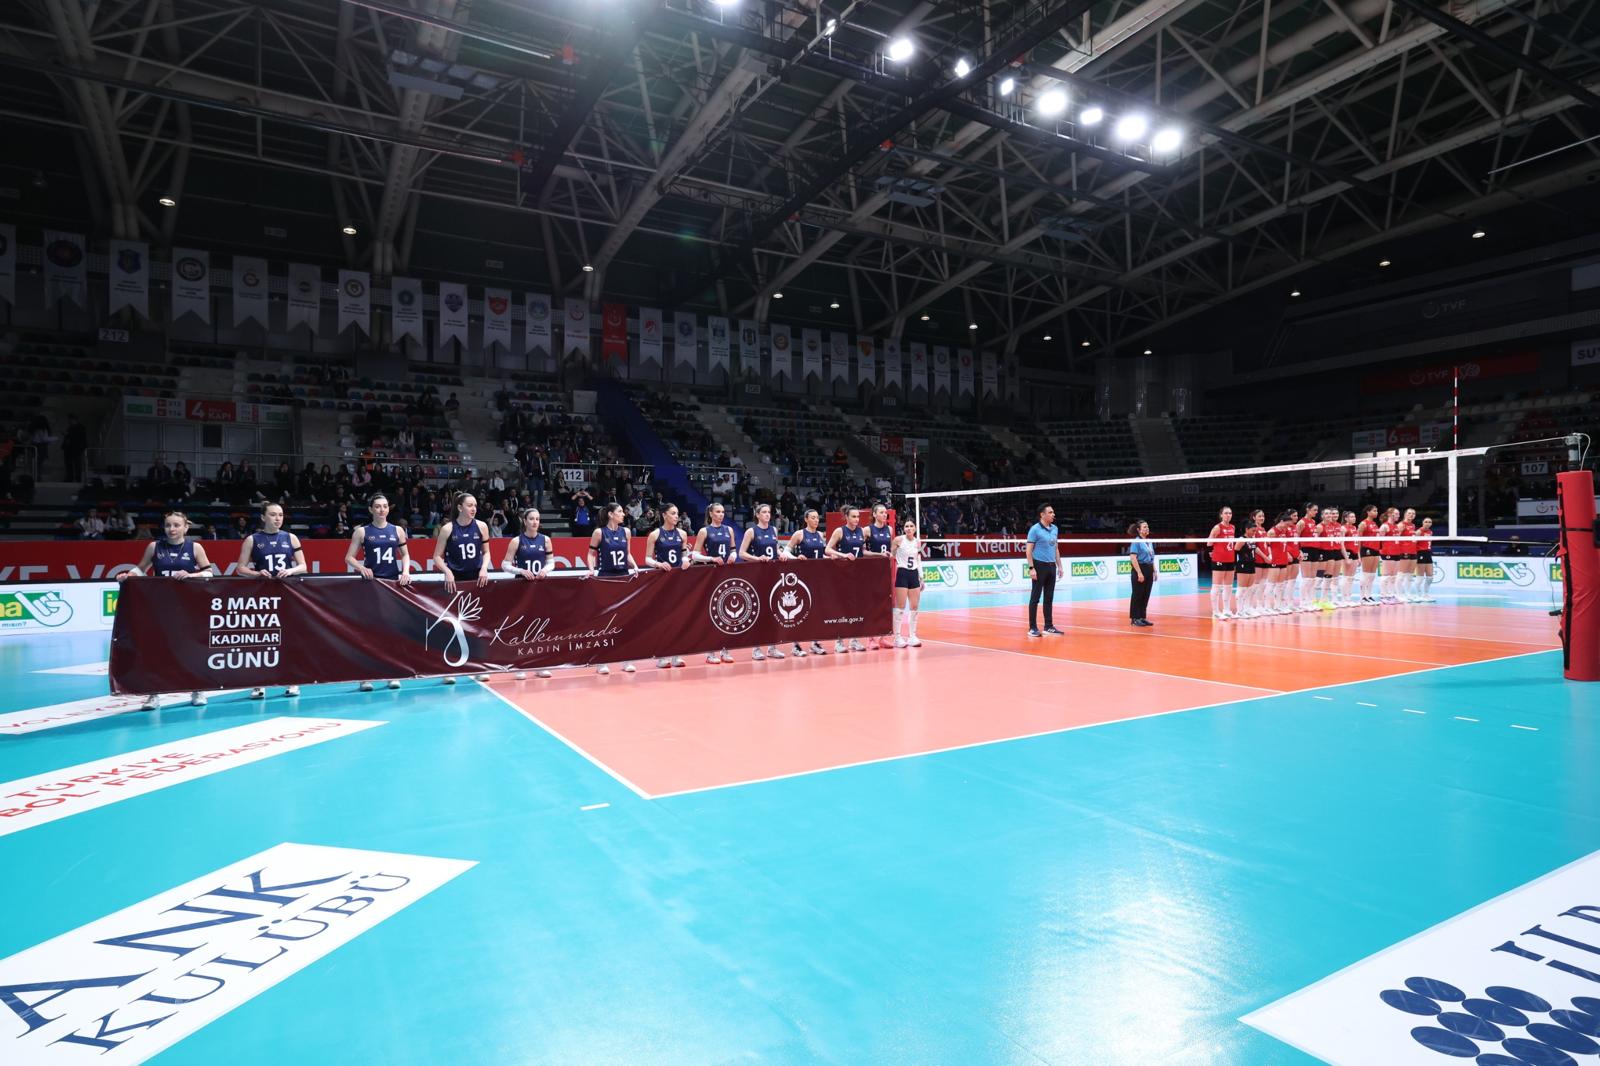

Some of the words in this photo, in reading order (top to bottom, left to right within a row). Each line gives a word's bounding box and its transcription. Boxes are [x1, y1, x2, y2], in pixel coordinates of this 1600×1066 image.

[103, 331, 125, 341] 212
[191, 401, 204, 418] 4
[880, 438, 889, 452] 5
[564, 470, 582, 480] 112
[1524, 463, 1545, 473] 107
[373, 547, 394, 564] 14
[458, 543, 476, 560] 19
[610, 550, 625, 566] 12
[668, 549, 677, 564] 6
[718, 544, 726, 558] 4
[765, 546, 774, 559] 9
[852, 547, 860, 557] 7
[265, 554, 286, 572] 13
[525, 560, 542, 575] 10
[907, 557, 914, 568] 5
[1072, 562, 1095, 575] iddaa
[1159, 560, 1179, 572] iddaa
[969, 567, 996, 580] iddaa
[1459, 563, 1504, 578] iddaa
[210, 597, 223, 611] 8
[227, 596, 282, 611] MART
[209, 611, 281, 629] DÜNYA
[211, 632, 280, 645] KADINLAR
[518, 644, 560, 656] KADIN
[569, 638, 615, 651] İMZASI
[207, 647, 280, 670] GÜNÜ
[102, 722, 342, 786] FEDERASYONU
[46, 871, 411, 1055] KULÜBÜ
